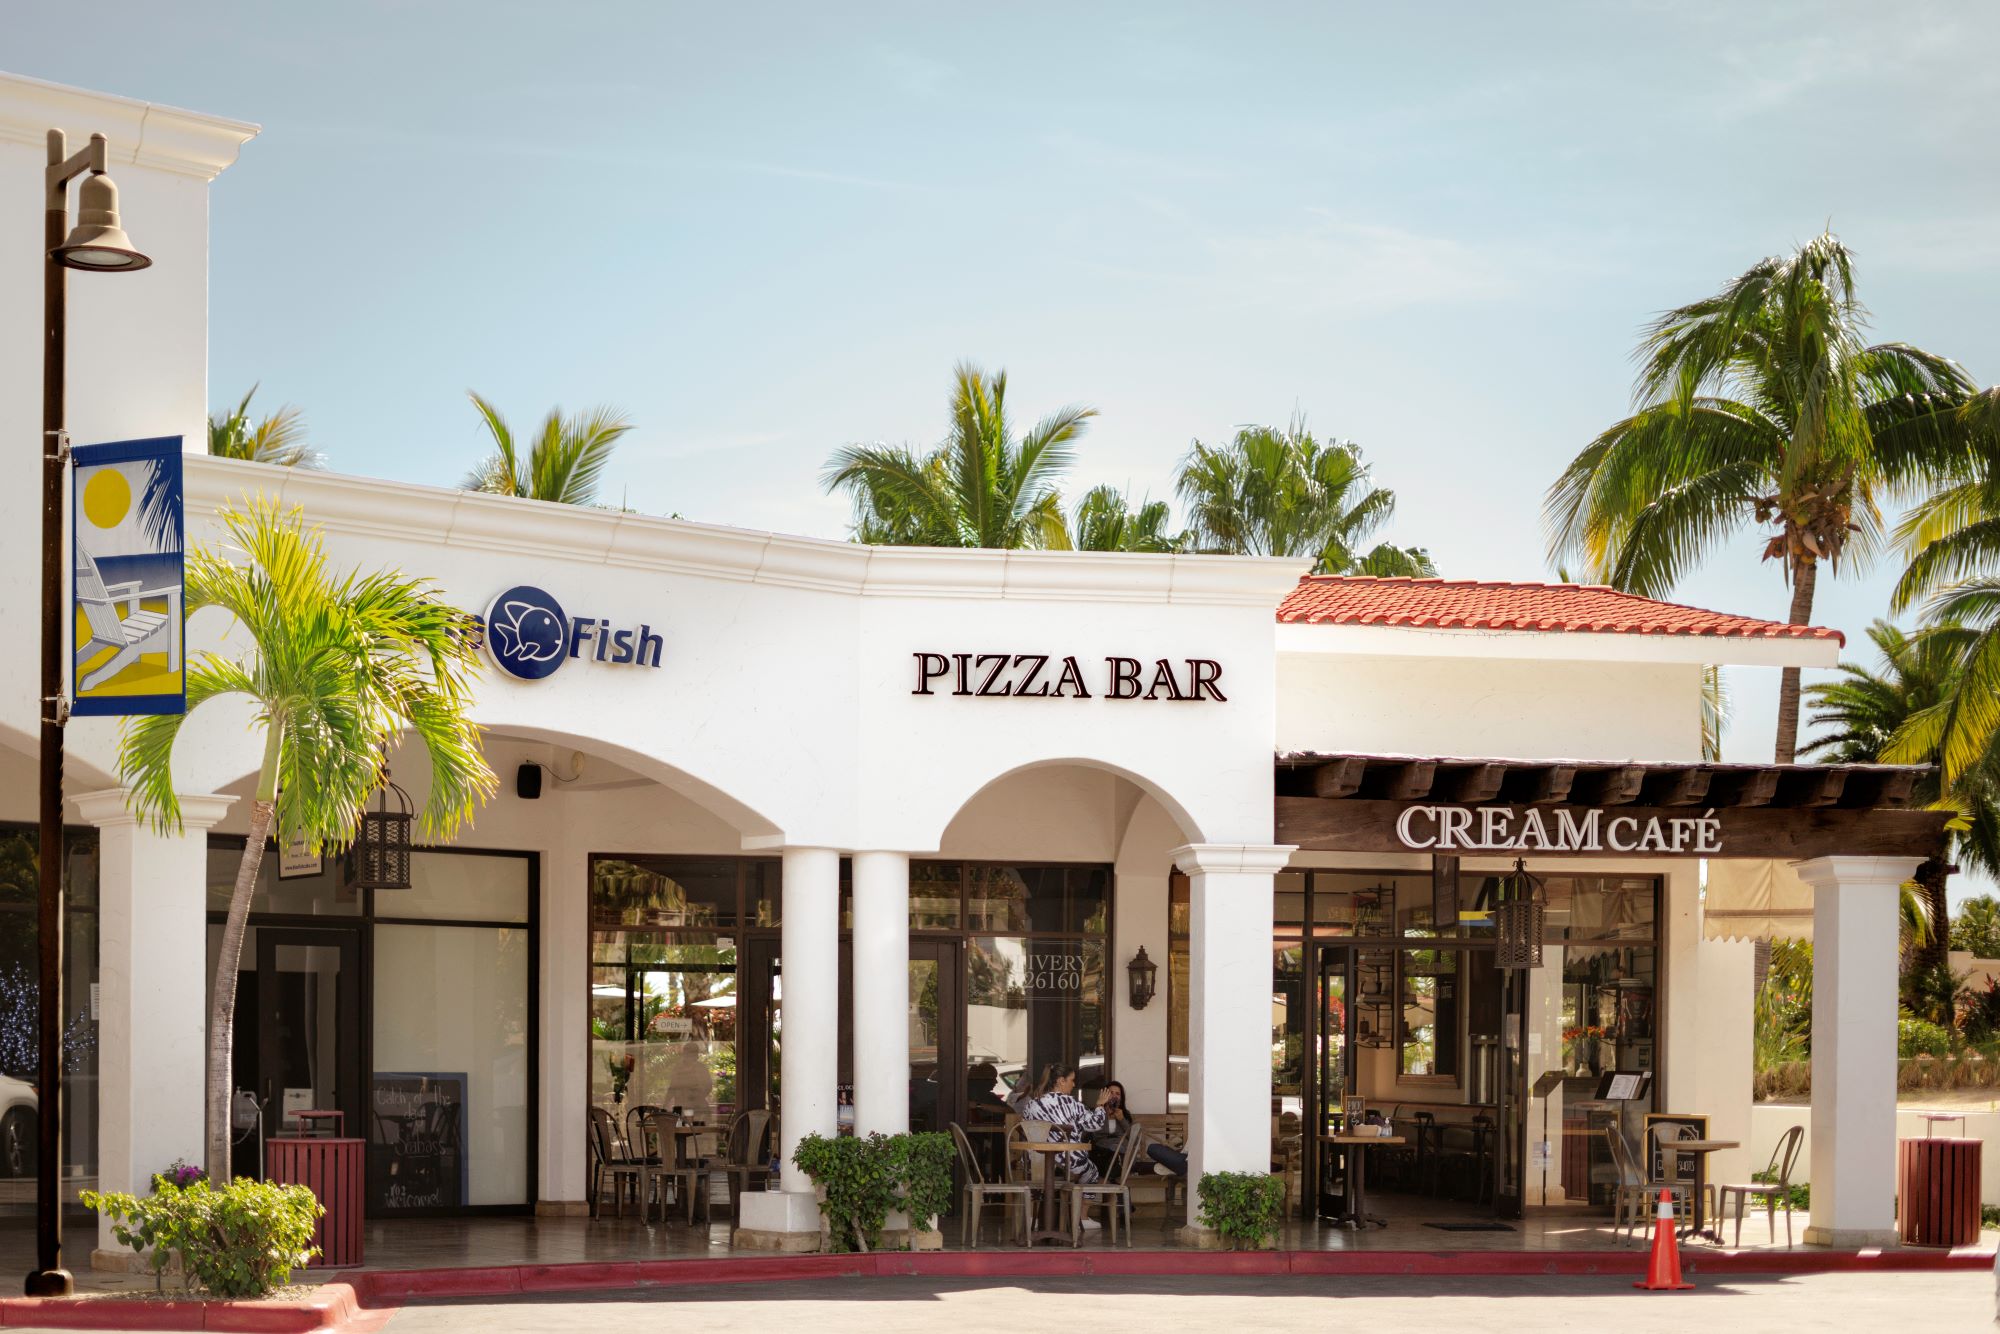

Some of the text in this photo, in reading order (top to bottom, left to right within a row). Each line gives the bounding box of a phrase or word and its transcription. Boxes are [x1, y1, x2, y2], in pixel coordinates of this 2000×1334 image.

[568, 616, 664, 668] Fish
[911, 652, 1228, 702] PIZZA BAR
[1396, 805, 1723, 853] CREAM CAFÉ
